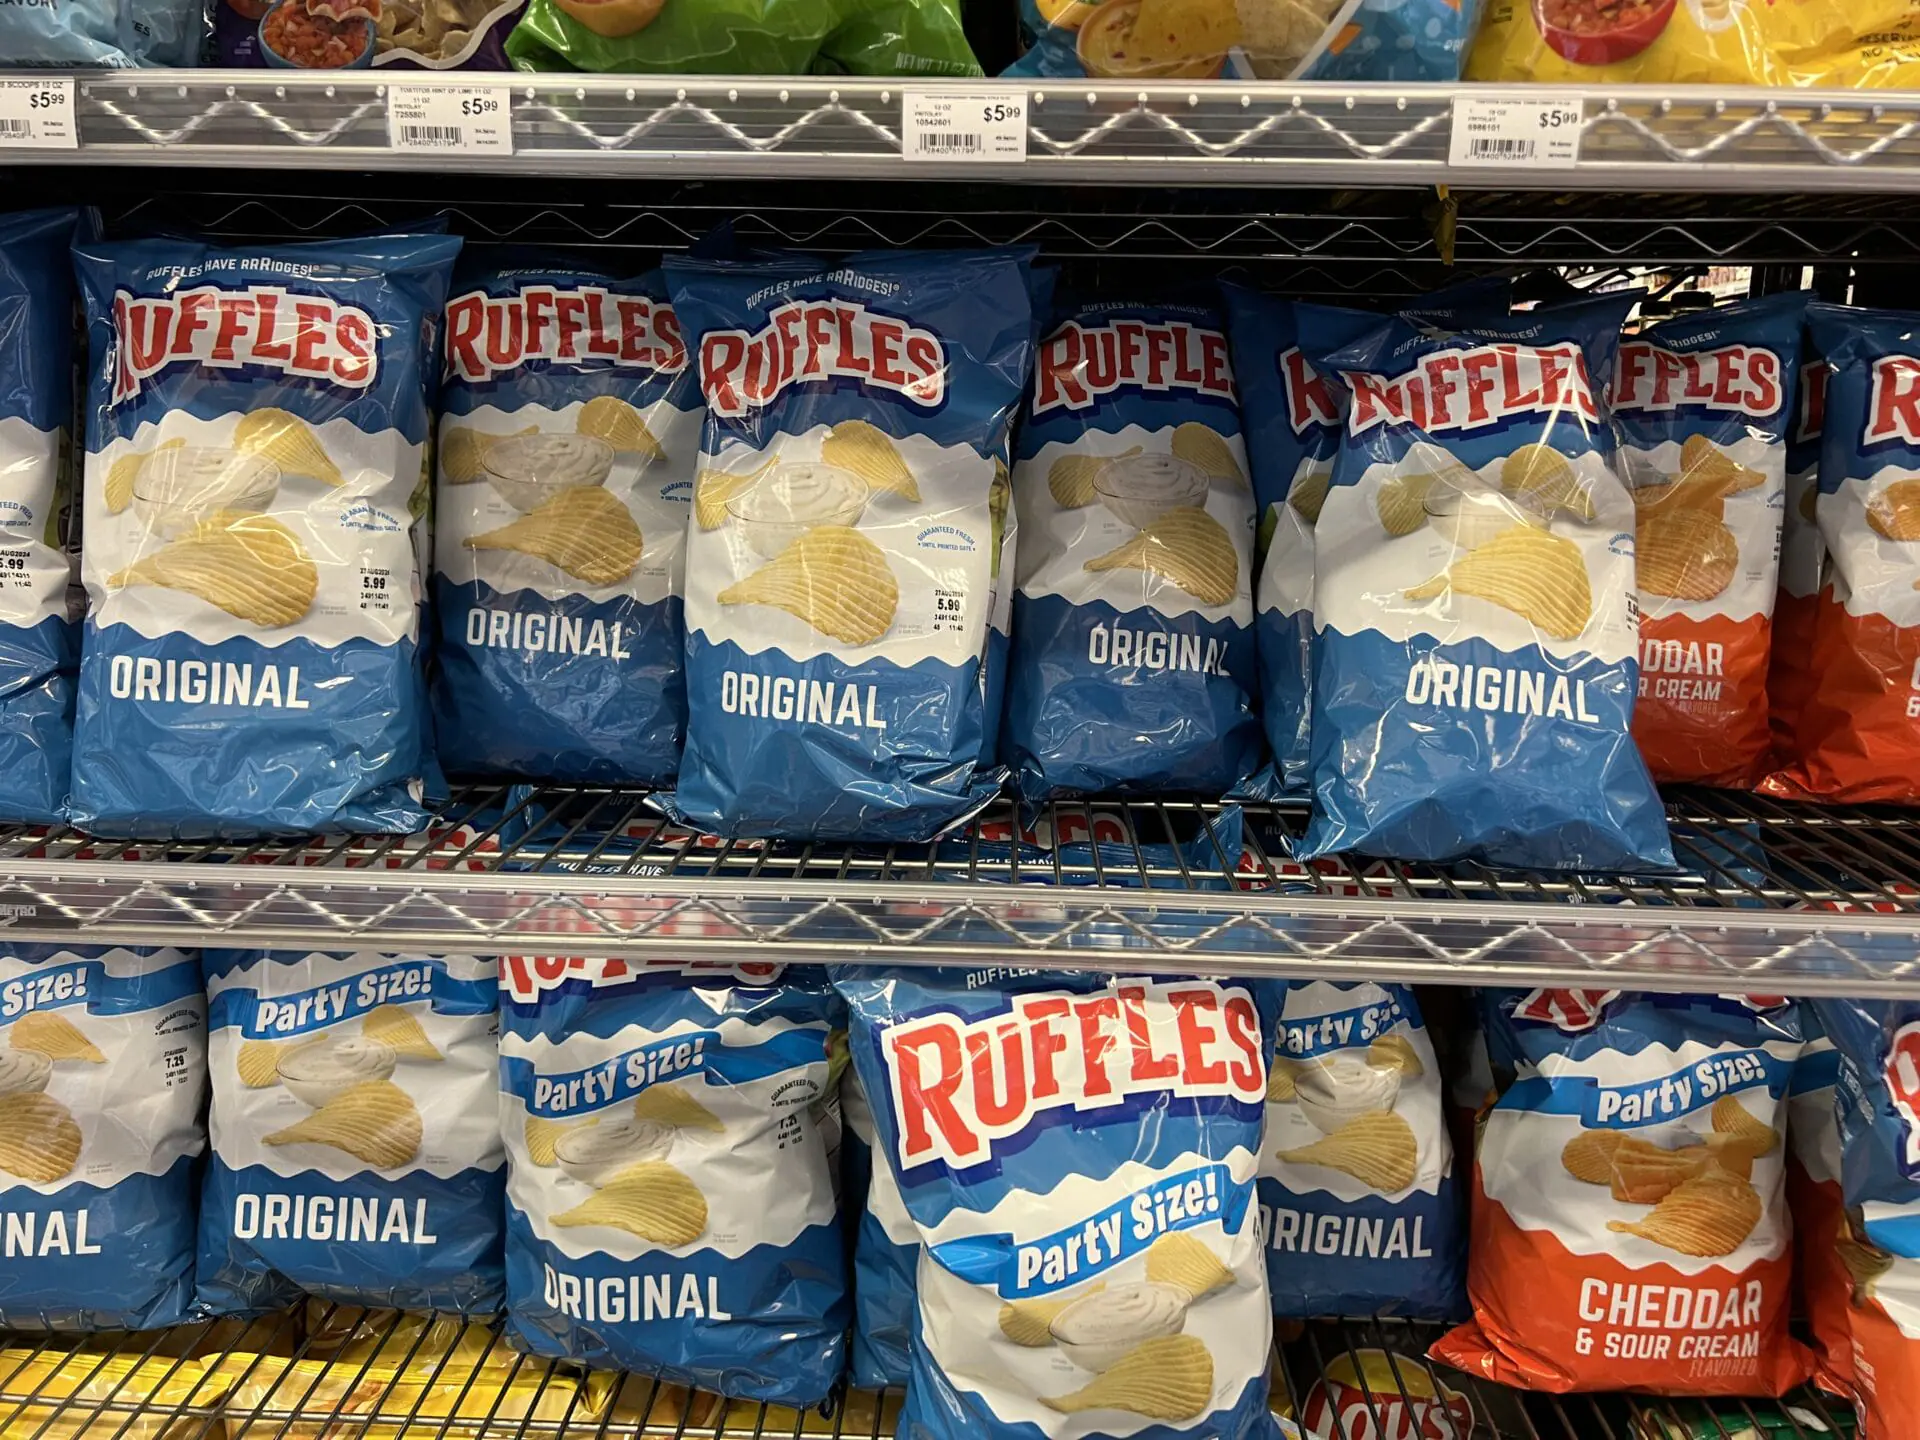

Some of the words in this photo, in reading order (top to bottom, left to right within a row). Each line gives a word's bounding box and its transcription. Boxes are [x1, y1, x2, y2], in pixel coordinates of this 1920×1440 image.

[146, 266, 202, 281] RUFFLES
[205, 258, 237, 273] HAVE
[746, 280, 790, 311] RUFFLES
[447, 291, 688, 378] RUFFLES
[702, 303, 942, 412] RUFFLES
[1038, 323, 1236, 406] RUFFLE
[917, 526, 955, 541] GUARANTEED
[955, 530, 975, 545] FRESH
[363, 576, 386, 589] 5.99
[938, 598, 961, 611] 5.99
[465, 608, 631, 659] ORIGINAL
[1088, 628, 1232, 677] ORIGINAL
[1639, 638, 1724, 676] DDAR
[110, 654, 310, 709] ORIGINAL
[721, 671, 887, 729] ORIGINAL
[1406, 662, 1600, 724] ORIGINAL
[1655, 678, 1722, 701] CREAM
[627, 863, 665, 876] HAVE
[2, 967, 87, 1016] Size!
[256, 983, 350, 1033] Party
[357, 966, 433, 1009] Size!
[165, 1054, 185, 1068] 7.29
[535, 1060, 618, 1112] Party
[627, 1037, 705, 1088] Size!
[892, 985, 1263, 1157] RUFFLES
[771, 1079, 806, 1101] GUARANTEED
[1598, 1074, 1693, 1122] Party
[1697, 1053, 1766, 1098] Size!
[0, 1209, 101, 1257] NAL
[234, 1193, 437, 1245] ORIGINAL
[1017, 1211, 1122, 1289] Party
[1131, 1172, 1219, 1241] Size!
[544, 1262, 731, 1323] ORIGINAL
[1578, 1276, 1763, 1330] CHEDDAR
[1575, 1328, 1595, 1355] &
[1604, 1334, 1671, 1360] SOUR
[1678, 1331, 1760, 1361] CREAM
[1689, 1358, 1758, 1378] FLAVORED
